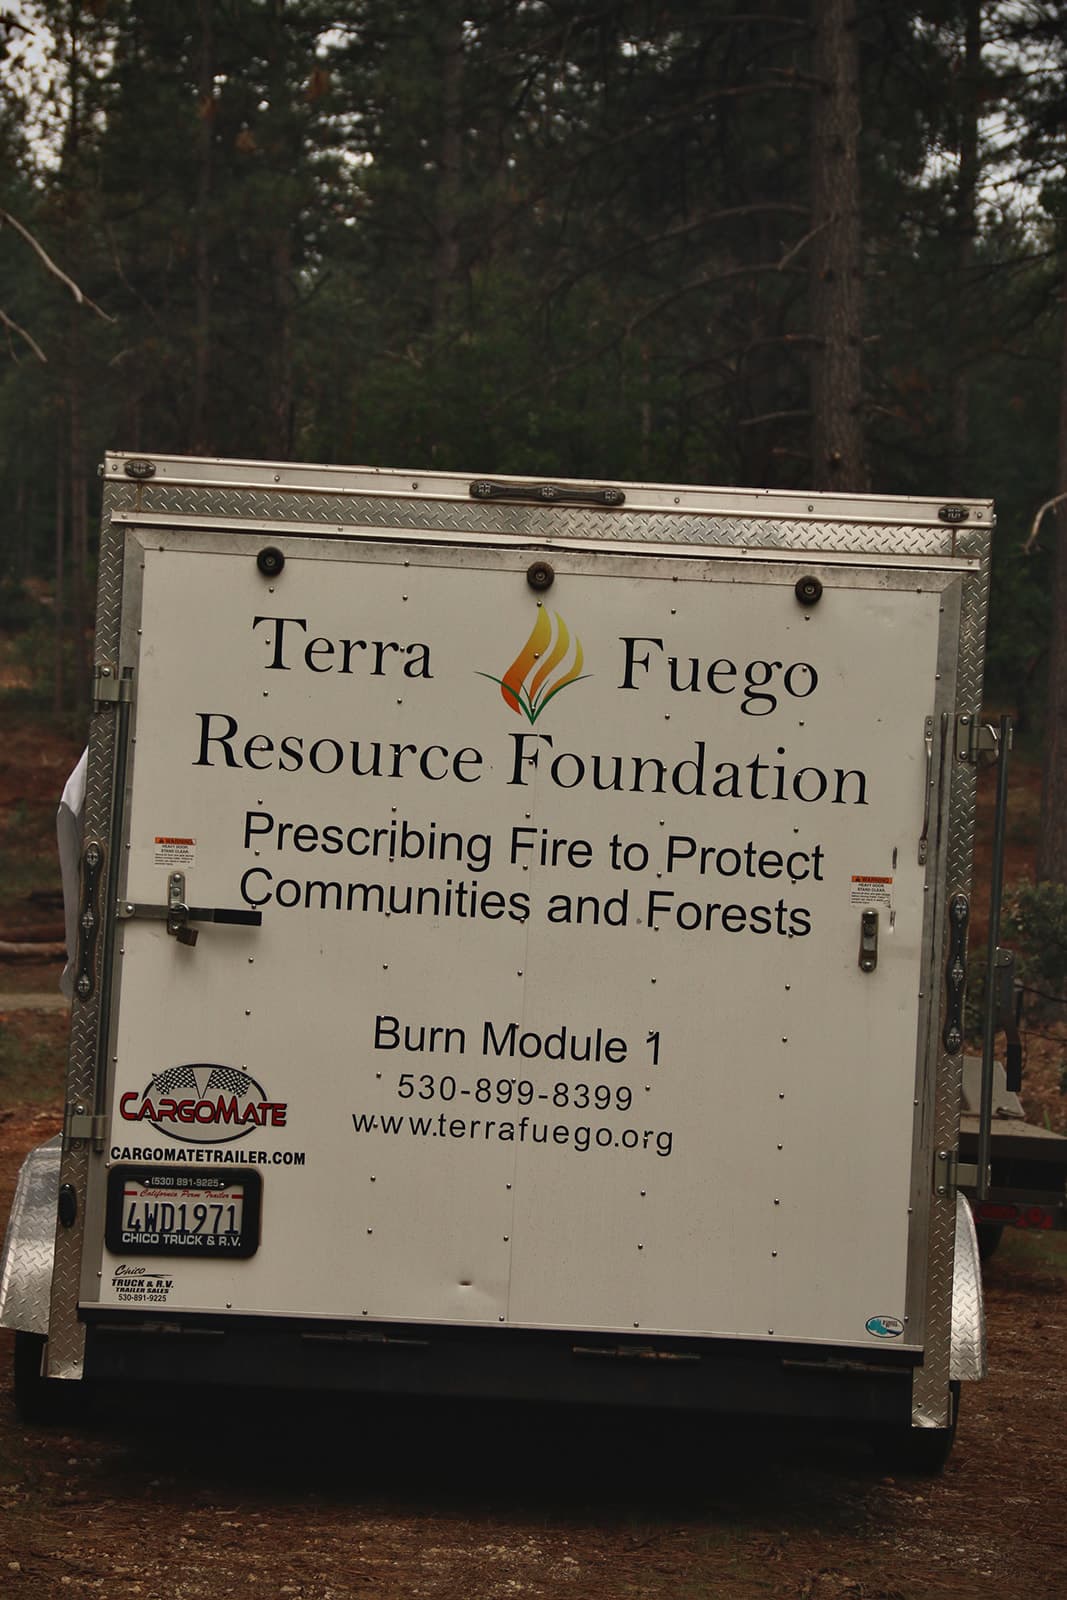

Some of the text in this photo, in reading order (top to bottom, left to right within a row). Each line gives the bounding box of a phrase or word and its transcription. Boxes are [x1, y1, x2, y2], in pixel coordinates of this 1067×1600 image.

[253, 615, 819, 716] Terra Fuego
[192, 712, 869, 805] Resource Foundation
[243, 811, 825, 881] Prescribing Fire to Protect
[240, 867, 812, 937] Communities and Forests
[374, 1015, 660, 1065] Burn Module 1
[397, 1073, 632, 1111] 530-899-8399
[351, 1112, 673, 1157] www.terrafuego.org
[110, 1146, 306, 1165] CARGOMATETRAILER.COM
[139, 1188, 230, 1199] California Perm Trailer
[151, 1177, 219, 1188] (530) 891-9225
[127, 1202, 240, 1235] 4WD1971
[122, 1232, 241, 1247] CHICO TRUCK & R.V.
[111, 1278, 145, 1287] TRUCK
[156, 1280, 174, 1289] R.V.
[114, 1264, 147, 1275] Chico
[118, 1293, 167, 1302] 530-891-9225
